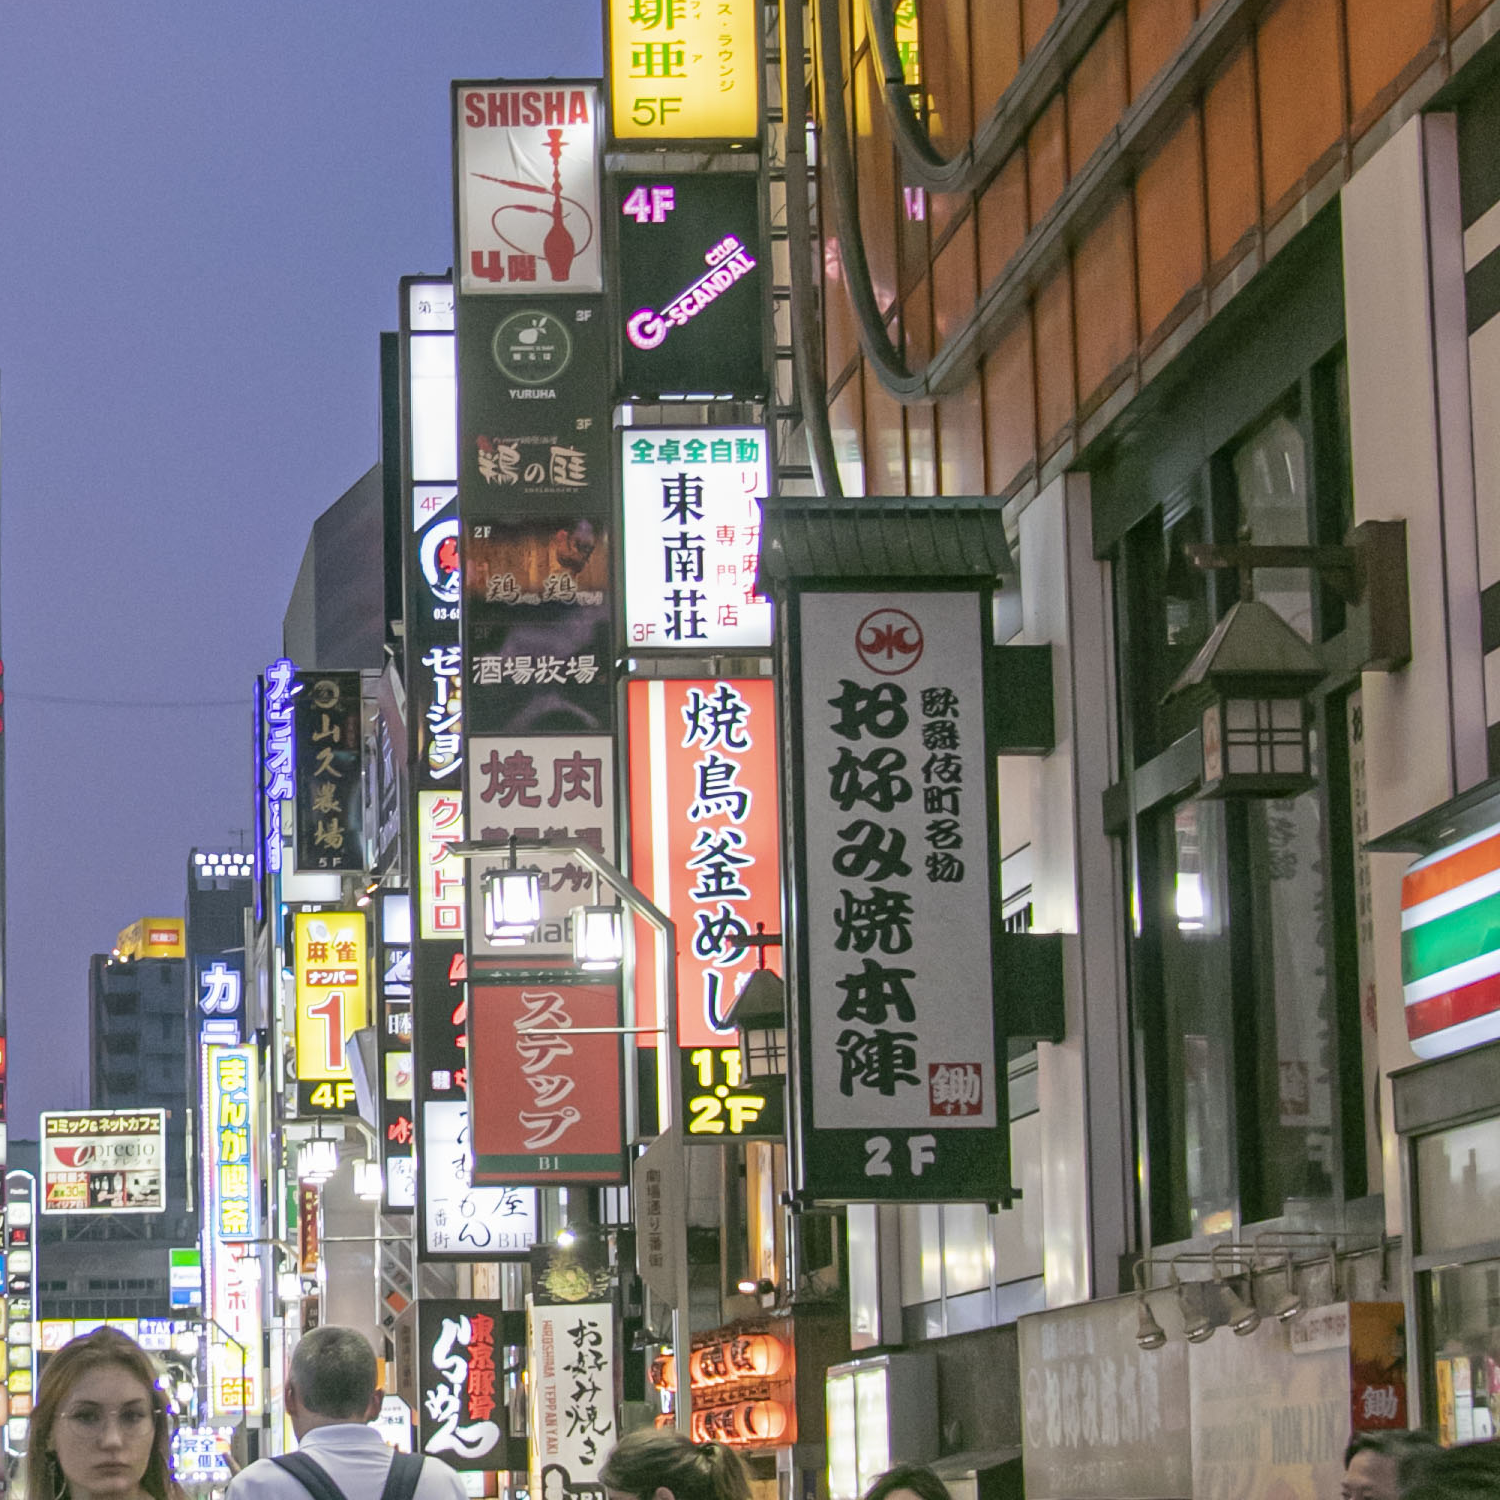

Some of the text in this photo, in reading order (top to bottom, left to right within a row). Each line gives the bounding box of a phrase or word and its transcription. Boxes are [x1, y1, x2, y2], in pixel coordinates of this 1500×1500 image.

[465, 91, 589, 128] SHISHA
[631, 98, 682, 127] 5F
[622, 186, 676, 223] 4F
[471, 251, 537, 283] 4階
[576, 310, 592, 321] 3F
[626, 252, 757, 350] G-SCANDAL
[509, 389, 556, 400] YURUHA
[477, 444, 589, 488] 鶏の庭
[630, 438, 760, 465] 全卓全自動
[420, 497, 443, 512] 4F
[474, 526, 492, 538] 2F
[661, 472, 709, 642] 東南荘
[716, 524, 739, 627] 専門店
[632, 623, 657, 643] 3F
[472, 655, 599, 685] 酒場牧場
[312, 713, 345, 850] 山久農場
[479, 749, 604, 809] 焼肉
[921, 685, 966, 885] 歌舞伎町名物
[318, 857, 342, 869] 5F
[430, 797, 464, 932] クアトロ
[684, 685, 753, 1036] 焼鳥釜めし
[828, 678, 922, 1099] お好み焼本陣
[306, 941, 358, 963] 麻雀
[308, 969, 358, 985] ナンバー
[308, 992, 345, 1071] 1
[512, 991, 581, 1151] ステップ
[311, 1083, 357, 1109] 4F
[689, 1095, 766, 1135] 2F
[218, 1058, 249, 1236] まんが喫茶
[538, 1156, 560, 1172] B1
[864, 1134, 937, 1177] 2F
[432, 1197, 451, 1249] 一番街
[646, 1167, 665, 1269] 劇場通り一番街
[498, 1232, 533, 1248] B1F
[467, 1313, 496, 1421] 東京豚骨
[541, 1319, 553, 1378] HIROSHIMA
[563, 1319, 613, 1466] お好み焼き
